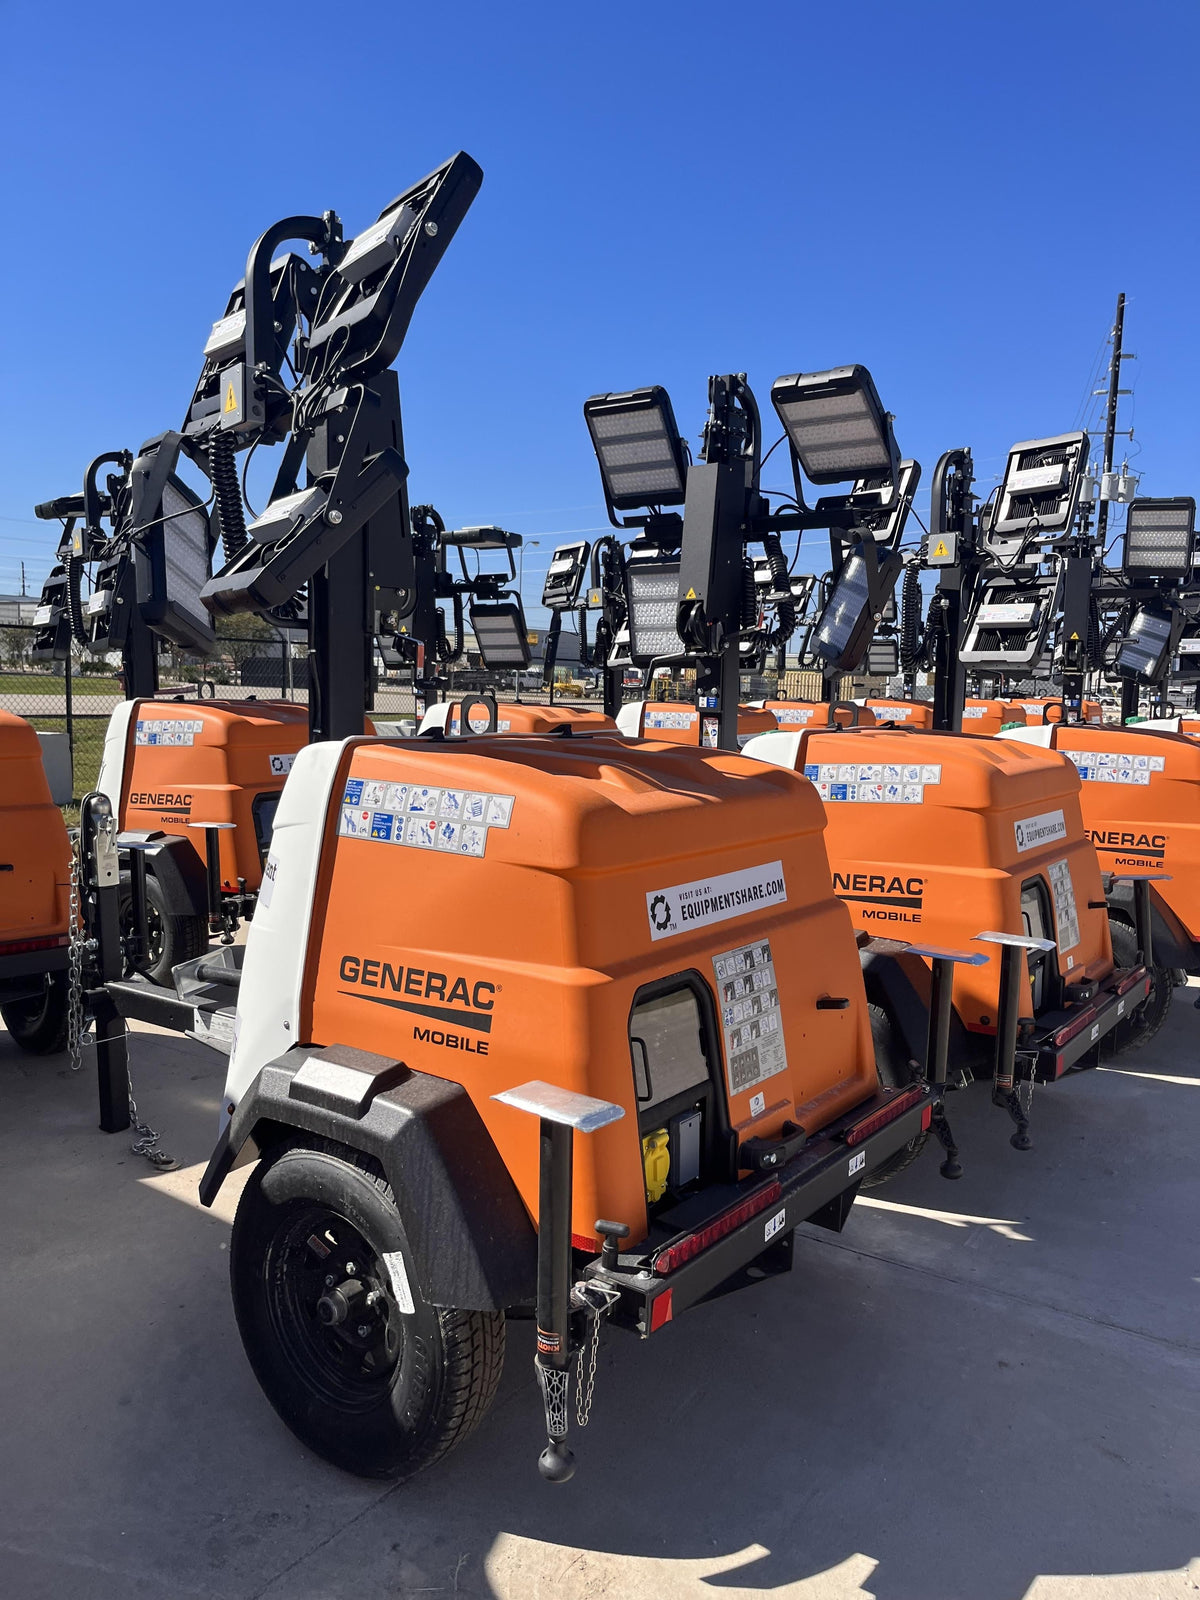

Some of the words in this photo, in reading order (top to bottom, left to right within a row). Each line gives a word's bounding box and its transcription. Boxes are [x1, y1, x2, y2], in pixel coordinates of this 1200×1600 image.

[130, 793, 192, 806] GENERAC
[1084, 830, 1166, 848] NERAC
[1115, 858, 1164, 868] MOBILE
[679, 891, 694, 901] VISIT
[695, 888, 702, 897] US
[704, 886, 713, 895] AT:
[832, 873, 924, 896] NERAC
[681, 878, 785, 921] EQUIPMENTSHARE.COM
[862, 910, 922, 923] MOBILE
[339, 955, 496, 1010] GENERAC
[413, 1027, 490, 1056] MOBILE
